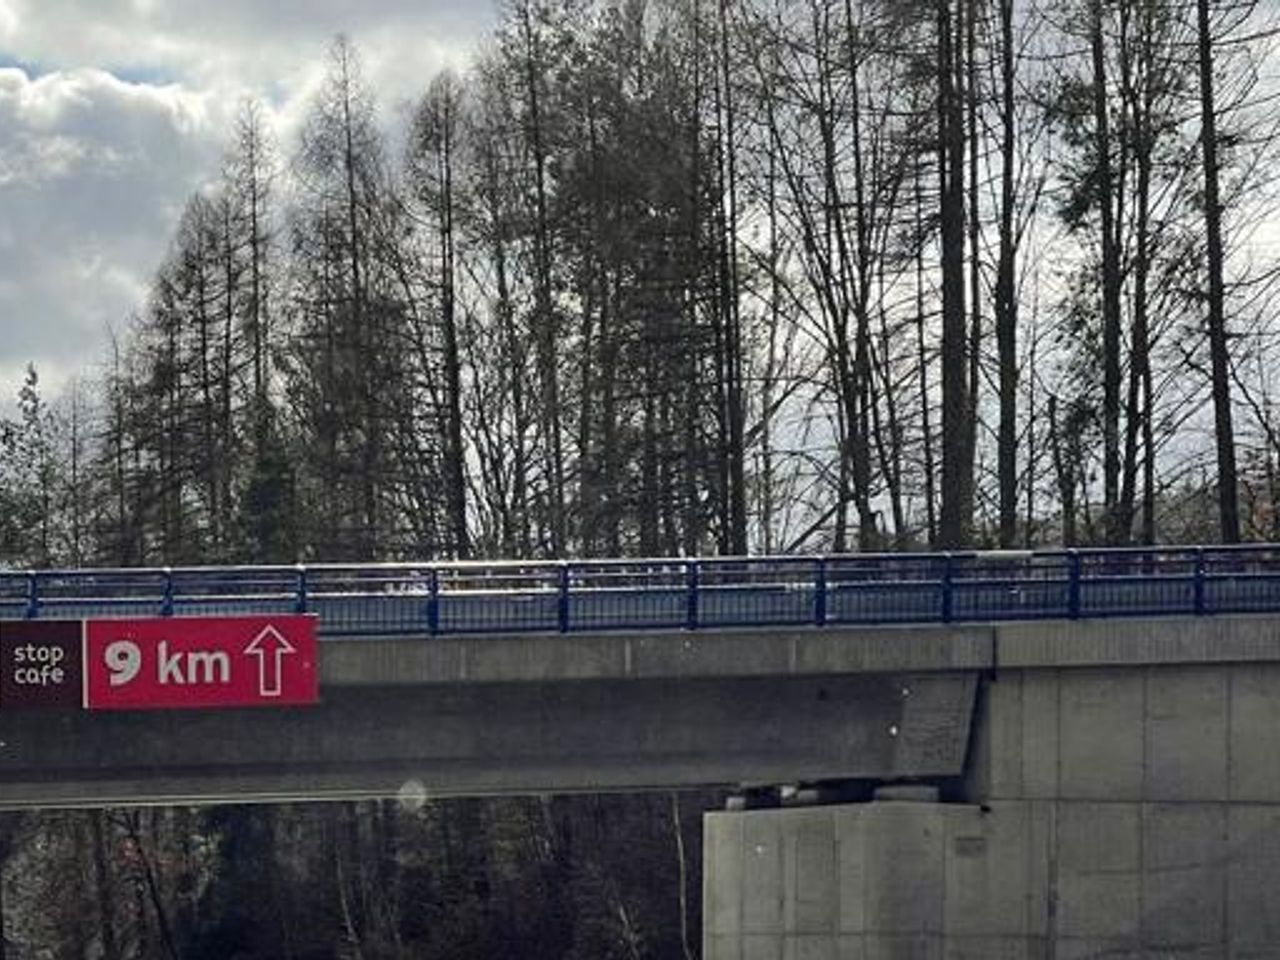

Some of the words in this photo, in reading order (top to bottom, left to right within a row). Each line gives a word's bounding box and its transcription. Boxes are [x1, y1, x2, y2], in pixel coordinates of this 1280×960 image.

[14, 643, 64, 666] stop
[105, 640, 141, 687] 9
[158, 640, 230, 684] km
[14, 664, 65, 686] cafe
